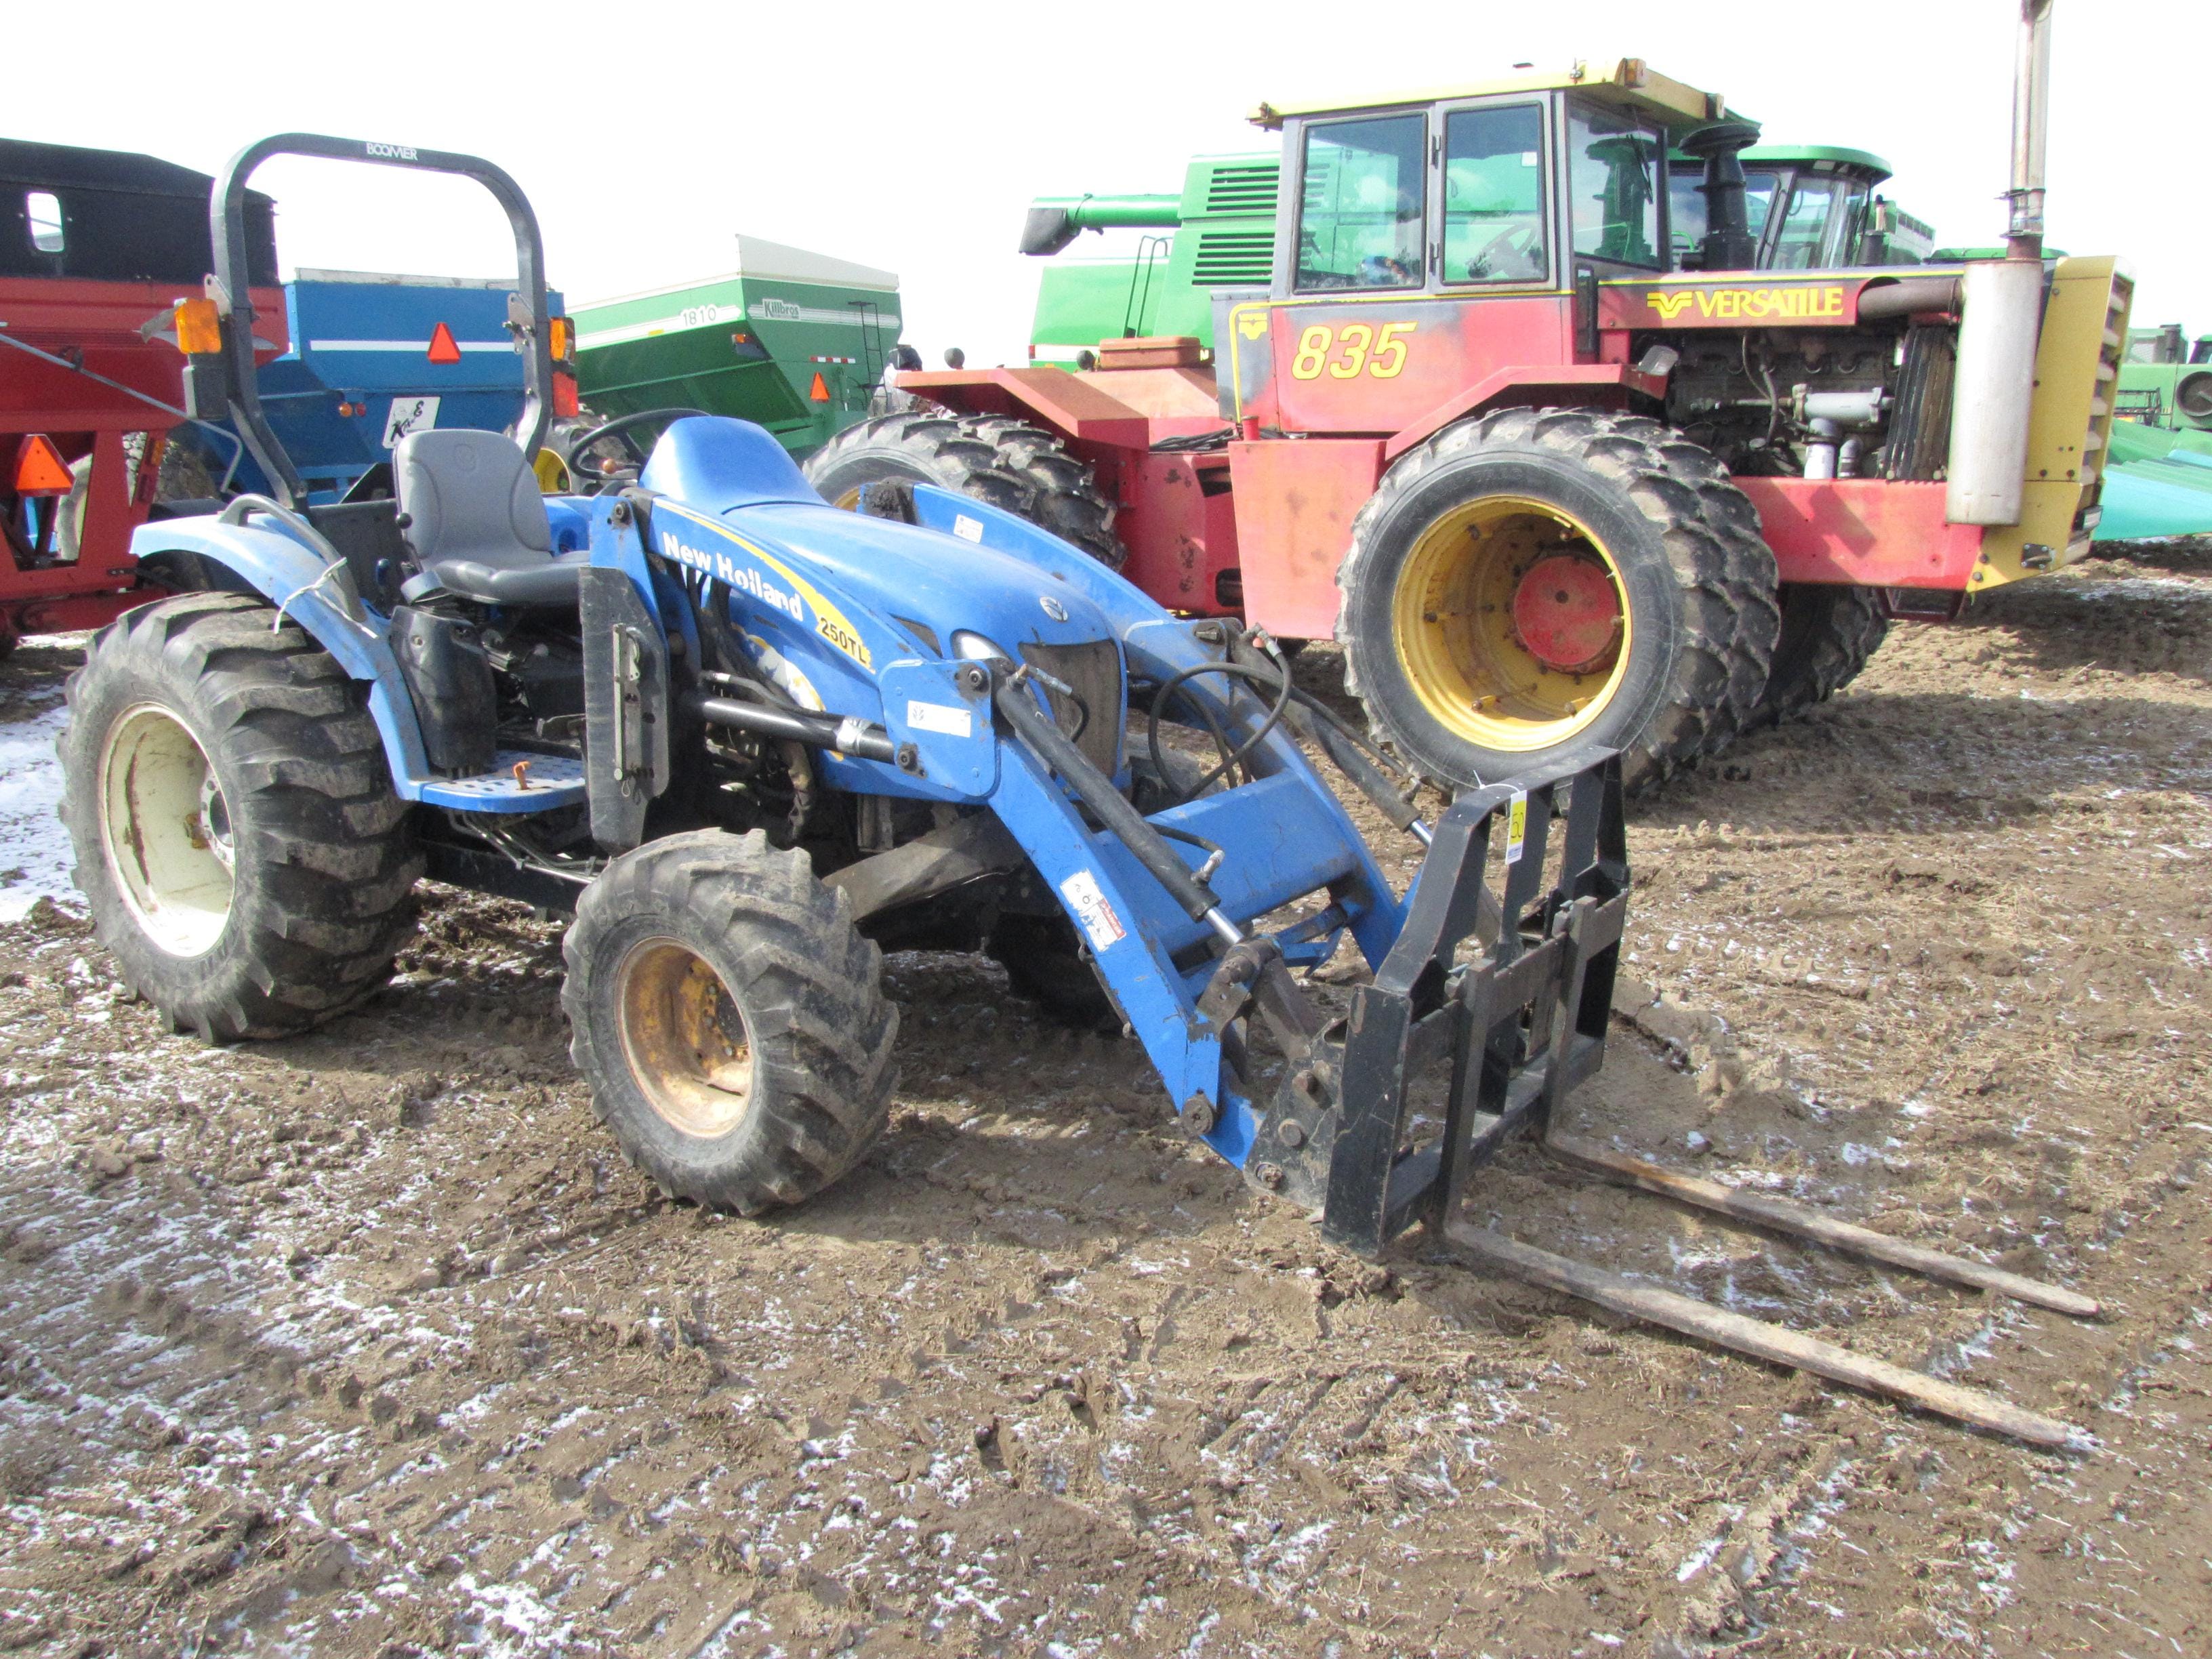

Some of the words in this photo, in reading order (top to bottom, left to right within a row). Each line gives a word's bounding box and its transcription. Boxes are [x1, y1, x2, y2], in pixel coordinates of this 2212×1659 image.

[367, 142, 418, 161] BOOMER
[683, 306, 716, 327] 1810
[764, 301, 799, 318] Killbros
[1695, 287, 1844, 318] VERSATILE
[1291, 321, 1419, 380] 835
[662, 531, 711, 571] New
[716, 552, 803, 621] Holland
[821, 617, 867, 664] 250TL
